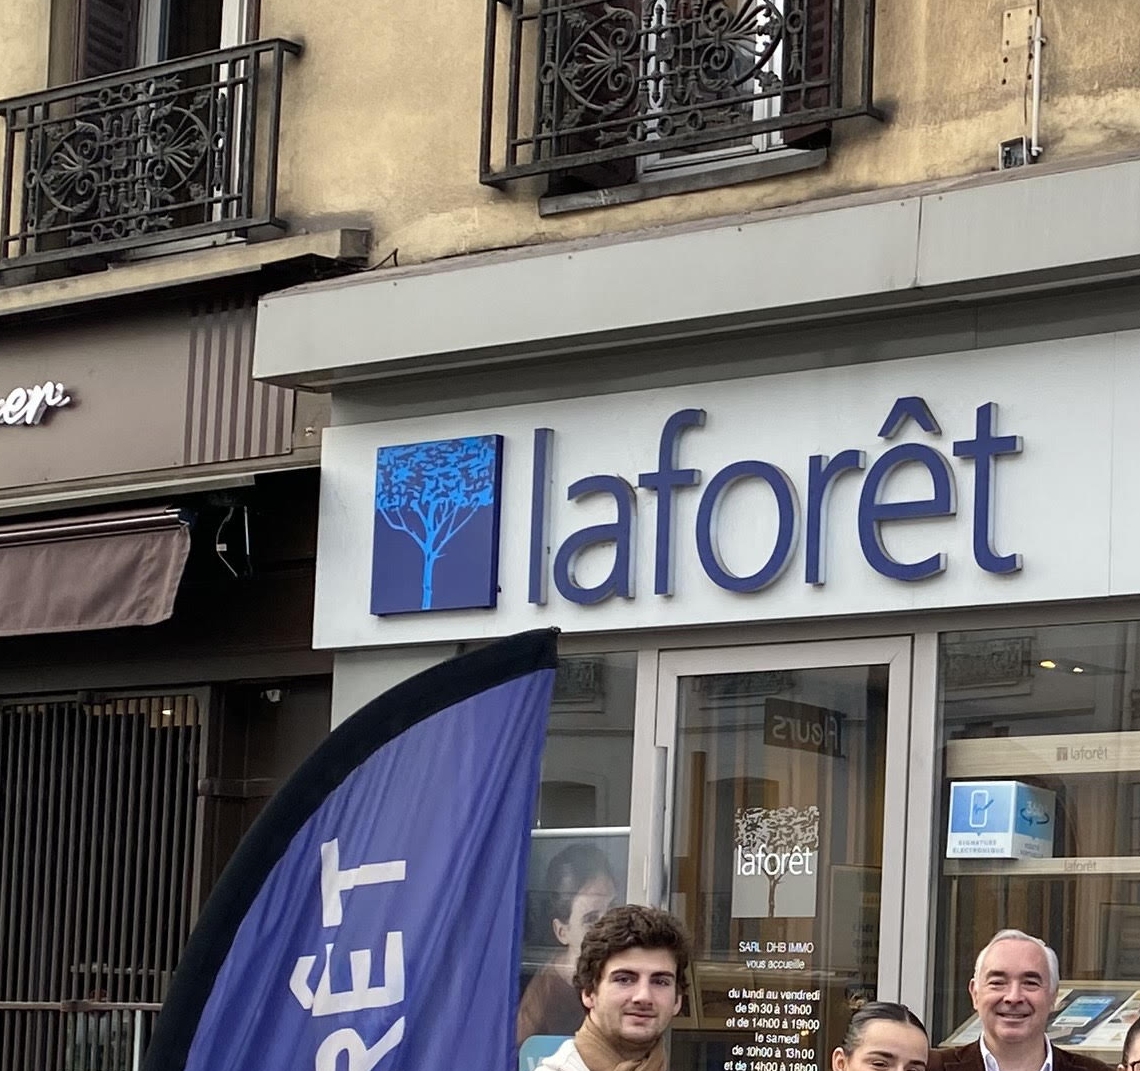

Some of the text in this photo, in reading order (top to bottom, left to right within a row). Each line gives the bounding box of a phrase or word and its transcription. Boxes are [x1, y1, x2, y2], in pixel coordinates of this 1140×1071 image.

[528, 396, 1023, 605] laforêt
[737, 844, 813, 876] laforêt
[788, 942, 814, 953] IMMO
[746, 959, 805, 969] vous accueille
[728, 988, 820, 1001] du lundi au vendredi
[774, 1003, 780, 1014] à
[783, 1004, 812, 1015] 13h00
[726, 1017, 820, 1030] et de 14h00 à 19h00
[755, 1032, 800, 1044] le samedi
[732, 1045, 815, 1060] de 10h00 à 13h00
[724, 1061, 733, 1070] et
[735, 1061, 747, 1071] de
[749, 1062, 778, 1071] 14h00
